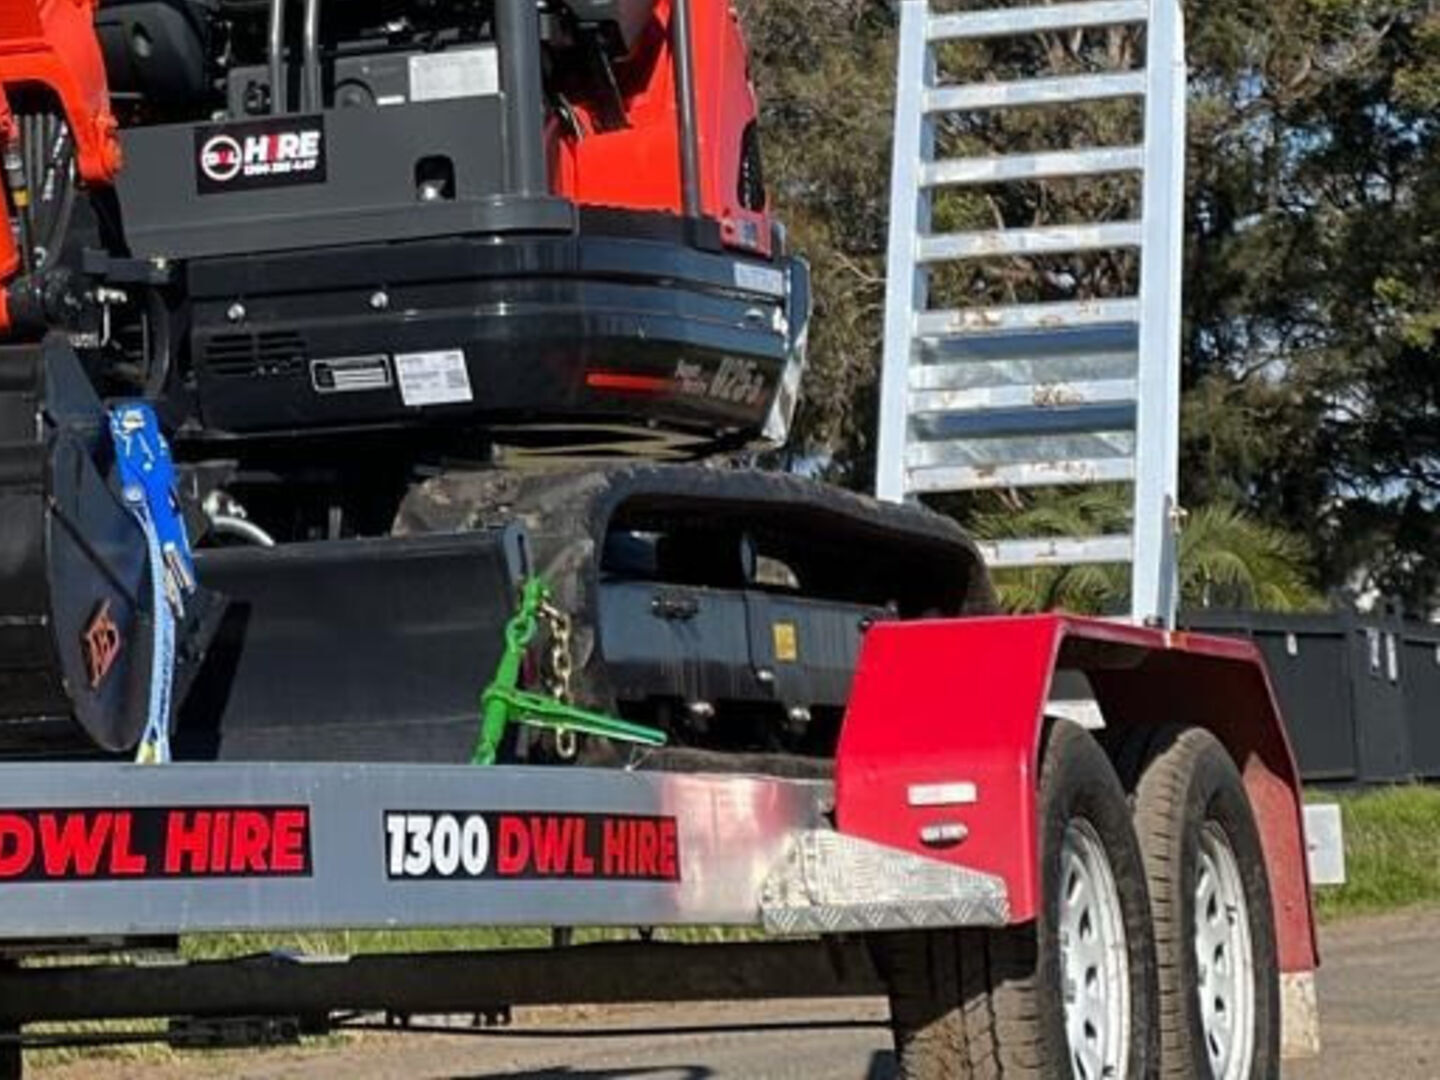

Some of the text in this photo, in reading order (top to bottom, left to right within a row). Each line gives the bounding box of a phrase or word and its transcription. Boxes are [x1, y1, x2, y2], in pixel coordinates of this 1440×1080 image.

[244, 130, 321, 164] HIRE
[165, 810, 306, 874] HIRE
[387, 813, 678, 877] 1300 DWL HIRE
